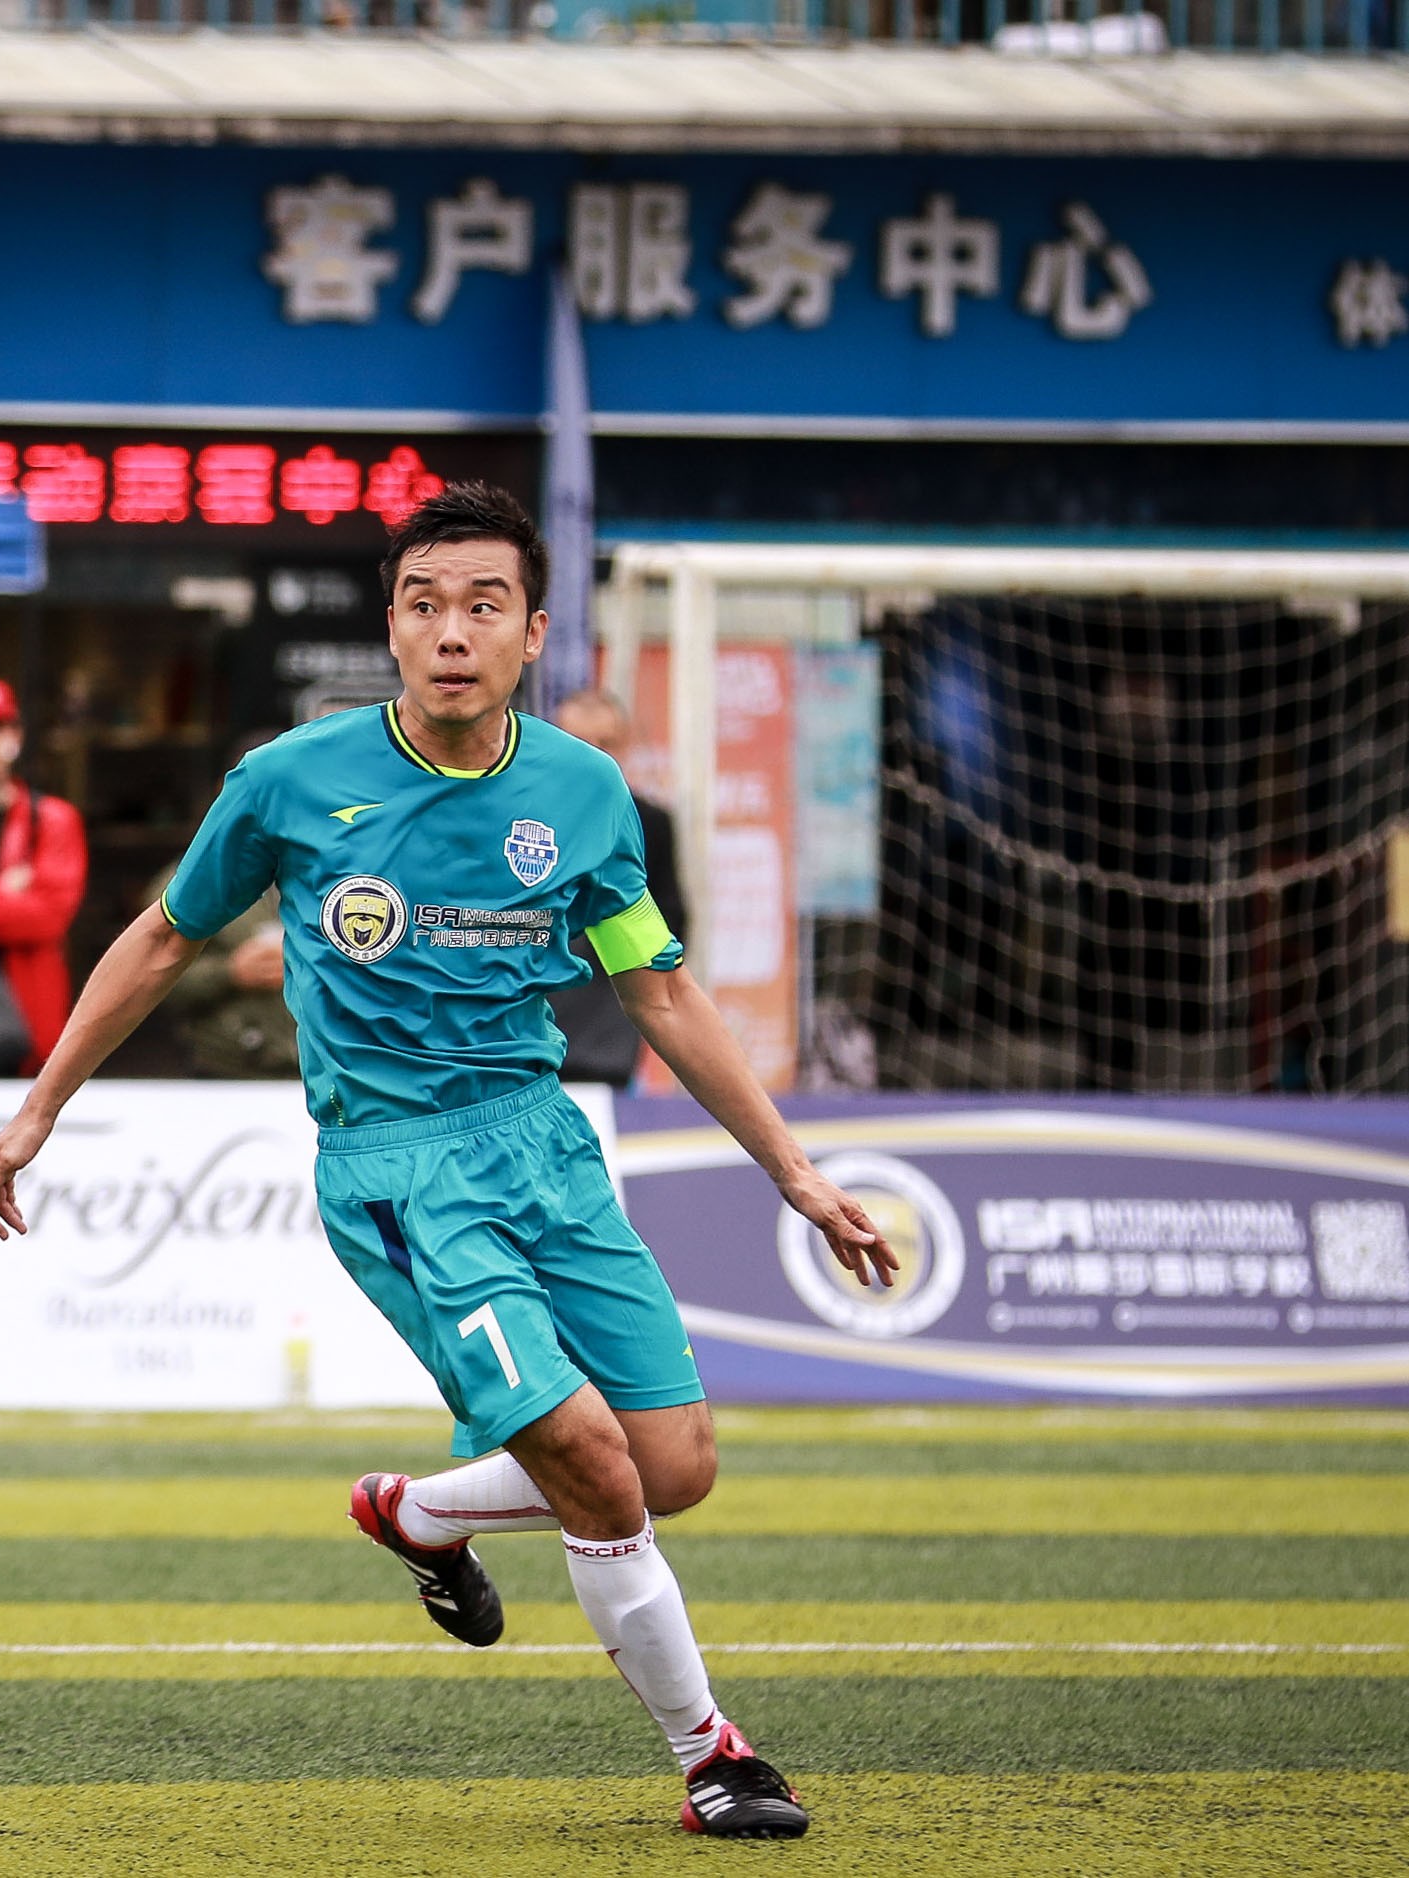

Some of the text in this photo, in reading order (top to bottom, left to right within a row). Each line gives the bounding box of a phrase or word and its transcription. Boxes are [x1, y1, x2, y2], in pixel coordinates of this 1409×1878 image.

[263, 176, 1152, 340] 客户服务中心
[413, 905, 462, 927] ISA
[462, 908, 553, 924] INTERNATIONAL
[413, 929, 550, 948] 广州爱莎国际学校
[457, 1301, 522, 1390] 7
